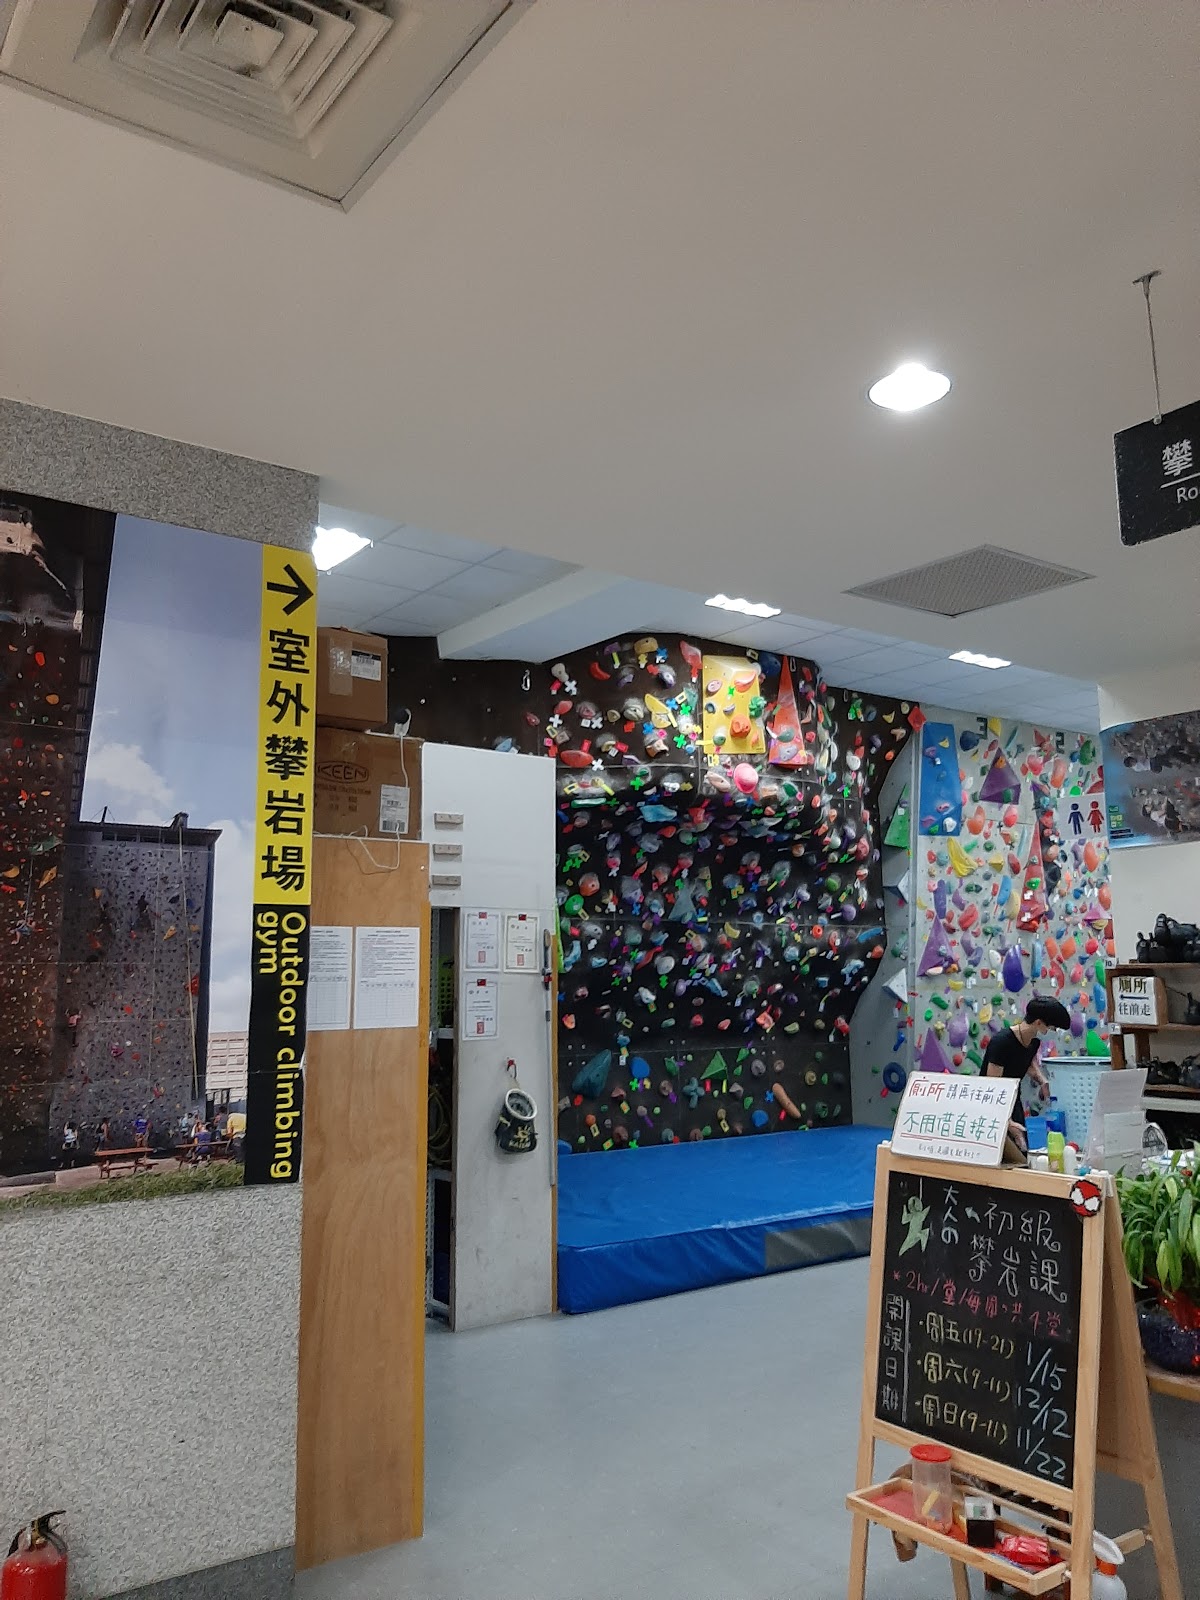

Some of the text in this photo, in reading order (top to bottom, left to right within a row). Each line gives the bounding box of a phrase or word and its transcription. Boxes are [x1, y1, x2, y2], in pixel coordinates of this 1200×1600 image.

[1162, 439, 1193, 477] 攀
[1176, 486, 1200, 504] RO
[261, 628, 310, 892] 室外攀岩場
[317, 764, 367, 780] KEEN
[255, 911, 279, 974] gym
[1118, 1001, 1151, 1016] 往前走
[270, 912, 307, 1179] Outdoor climbing
[902, 1111, 1001, 1143] 不用借直接去
[941, 1184, 960, 1245] 大人の
[984, 1201, 1062, 1253] 初級
[968, 1233, 1068, 1304] 攀岩課
[1017, 1385, 1072, 1439] 12/12
[1017, 1425, 1067, 1481] 11/22
